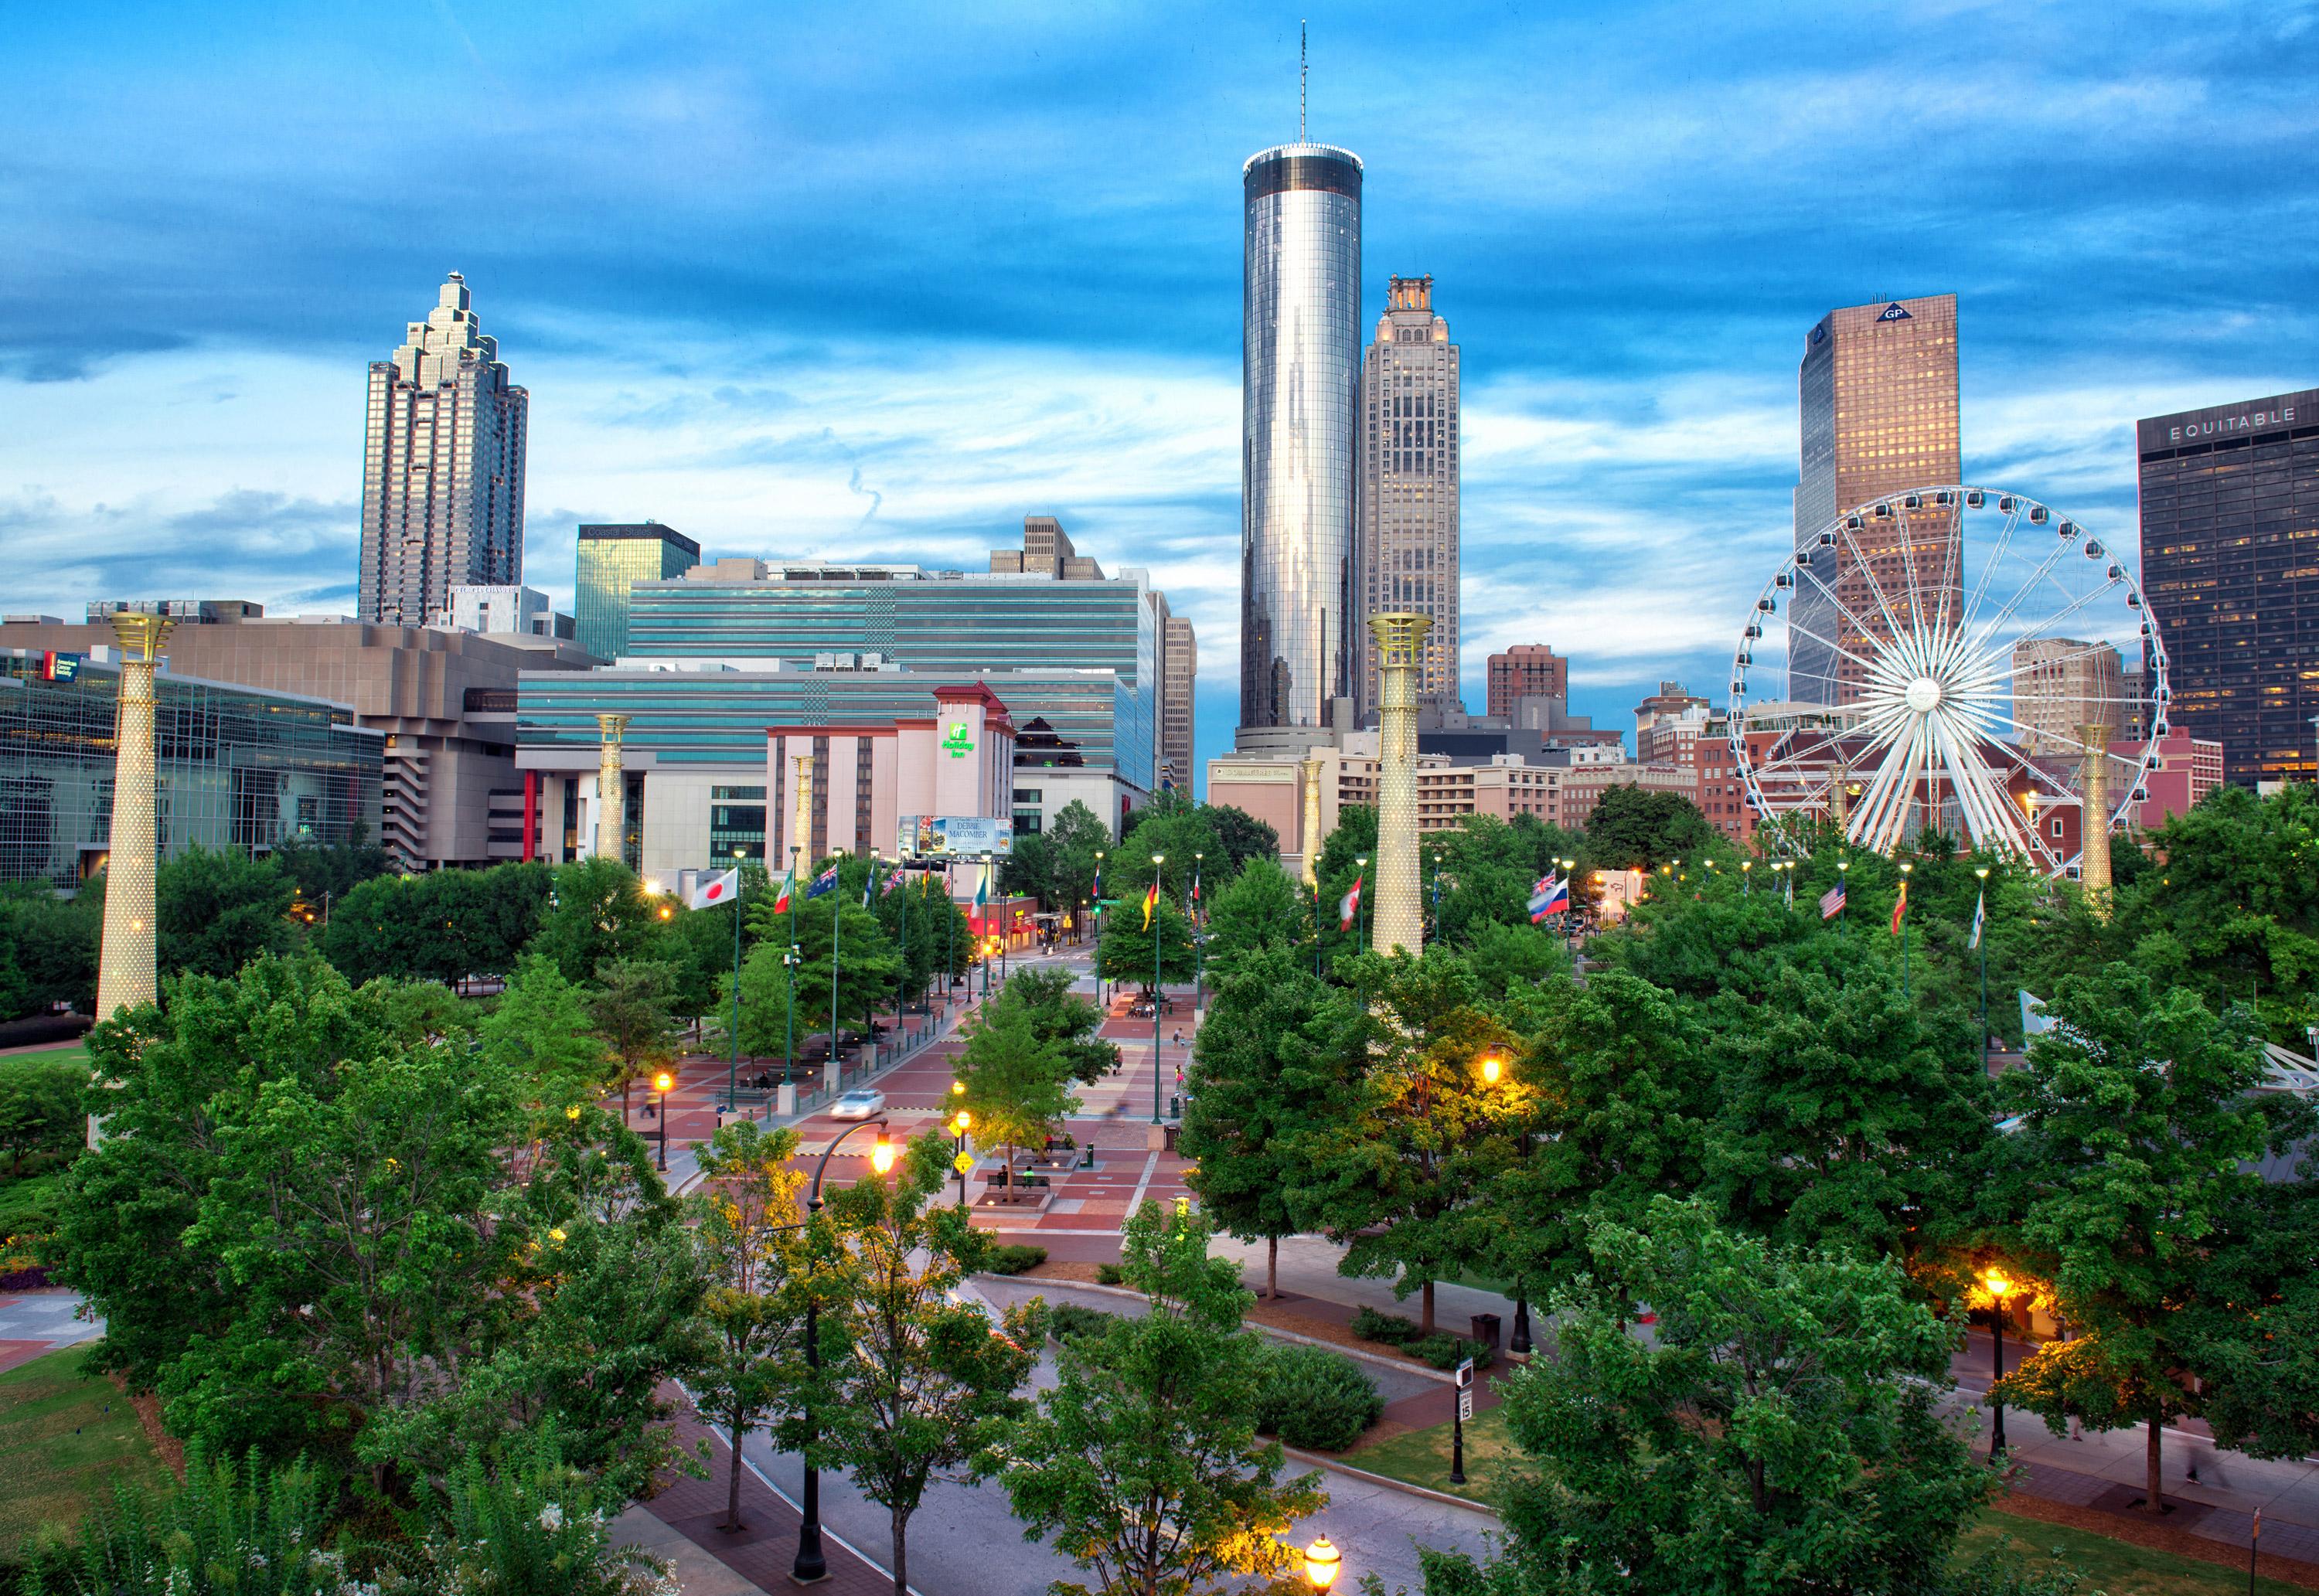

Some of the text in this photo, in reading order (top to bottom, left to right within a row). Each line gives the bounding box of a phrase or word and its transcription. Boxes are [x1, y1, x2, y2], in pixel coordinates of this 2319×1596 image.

[1885, 309, 1903, 318] GP
[2171, 407, 2295, 440] EQUITABLE
[587, 526, 652, 536] Coastal States
[56, 658, 77, 667] American
[56, 669, 73, 677] Society
[942, 740, 975, 751] Holiday
[951, 750, 965, 758] Inn
[957, 822, 980, 830] DEBBIE
[948, 830, 988, 839] MACOMBER
[1463, 1406, 1470, 1418] 15
